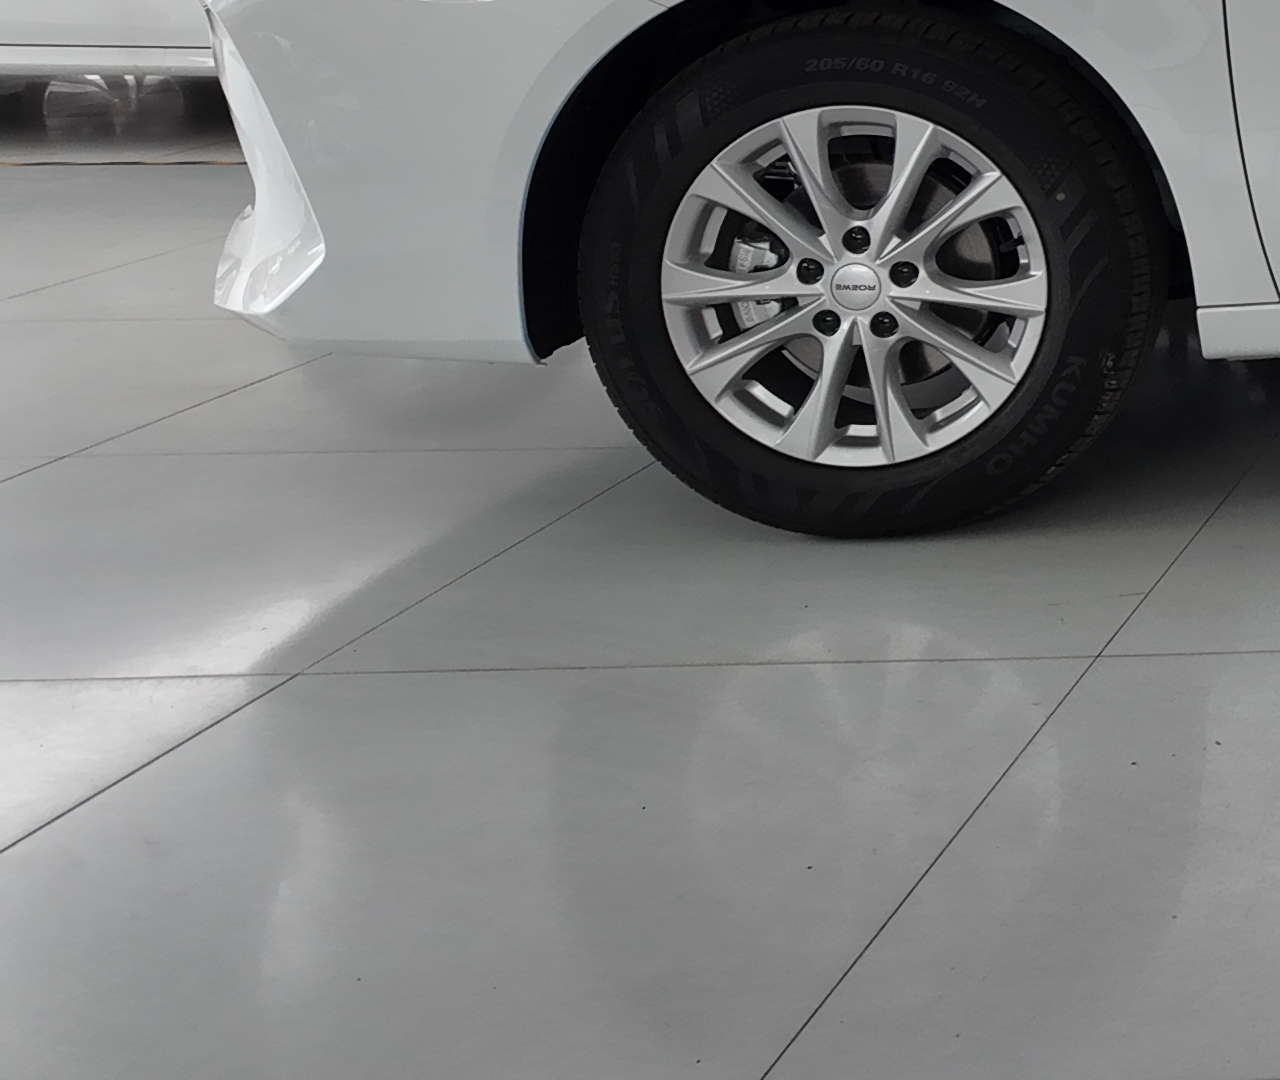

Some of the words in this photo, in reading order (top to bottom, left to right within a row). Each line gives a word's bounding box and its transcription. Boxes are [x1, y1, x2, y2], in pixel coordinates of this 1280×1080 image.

[805, 57, 885, 72] 205/60
[891, 63, 938, 85] R16
[941, 80, 988, 109] 92H
[986, 355, 1088, 474] KUMHO
